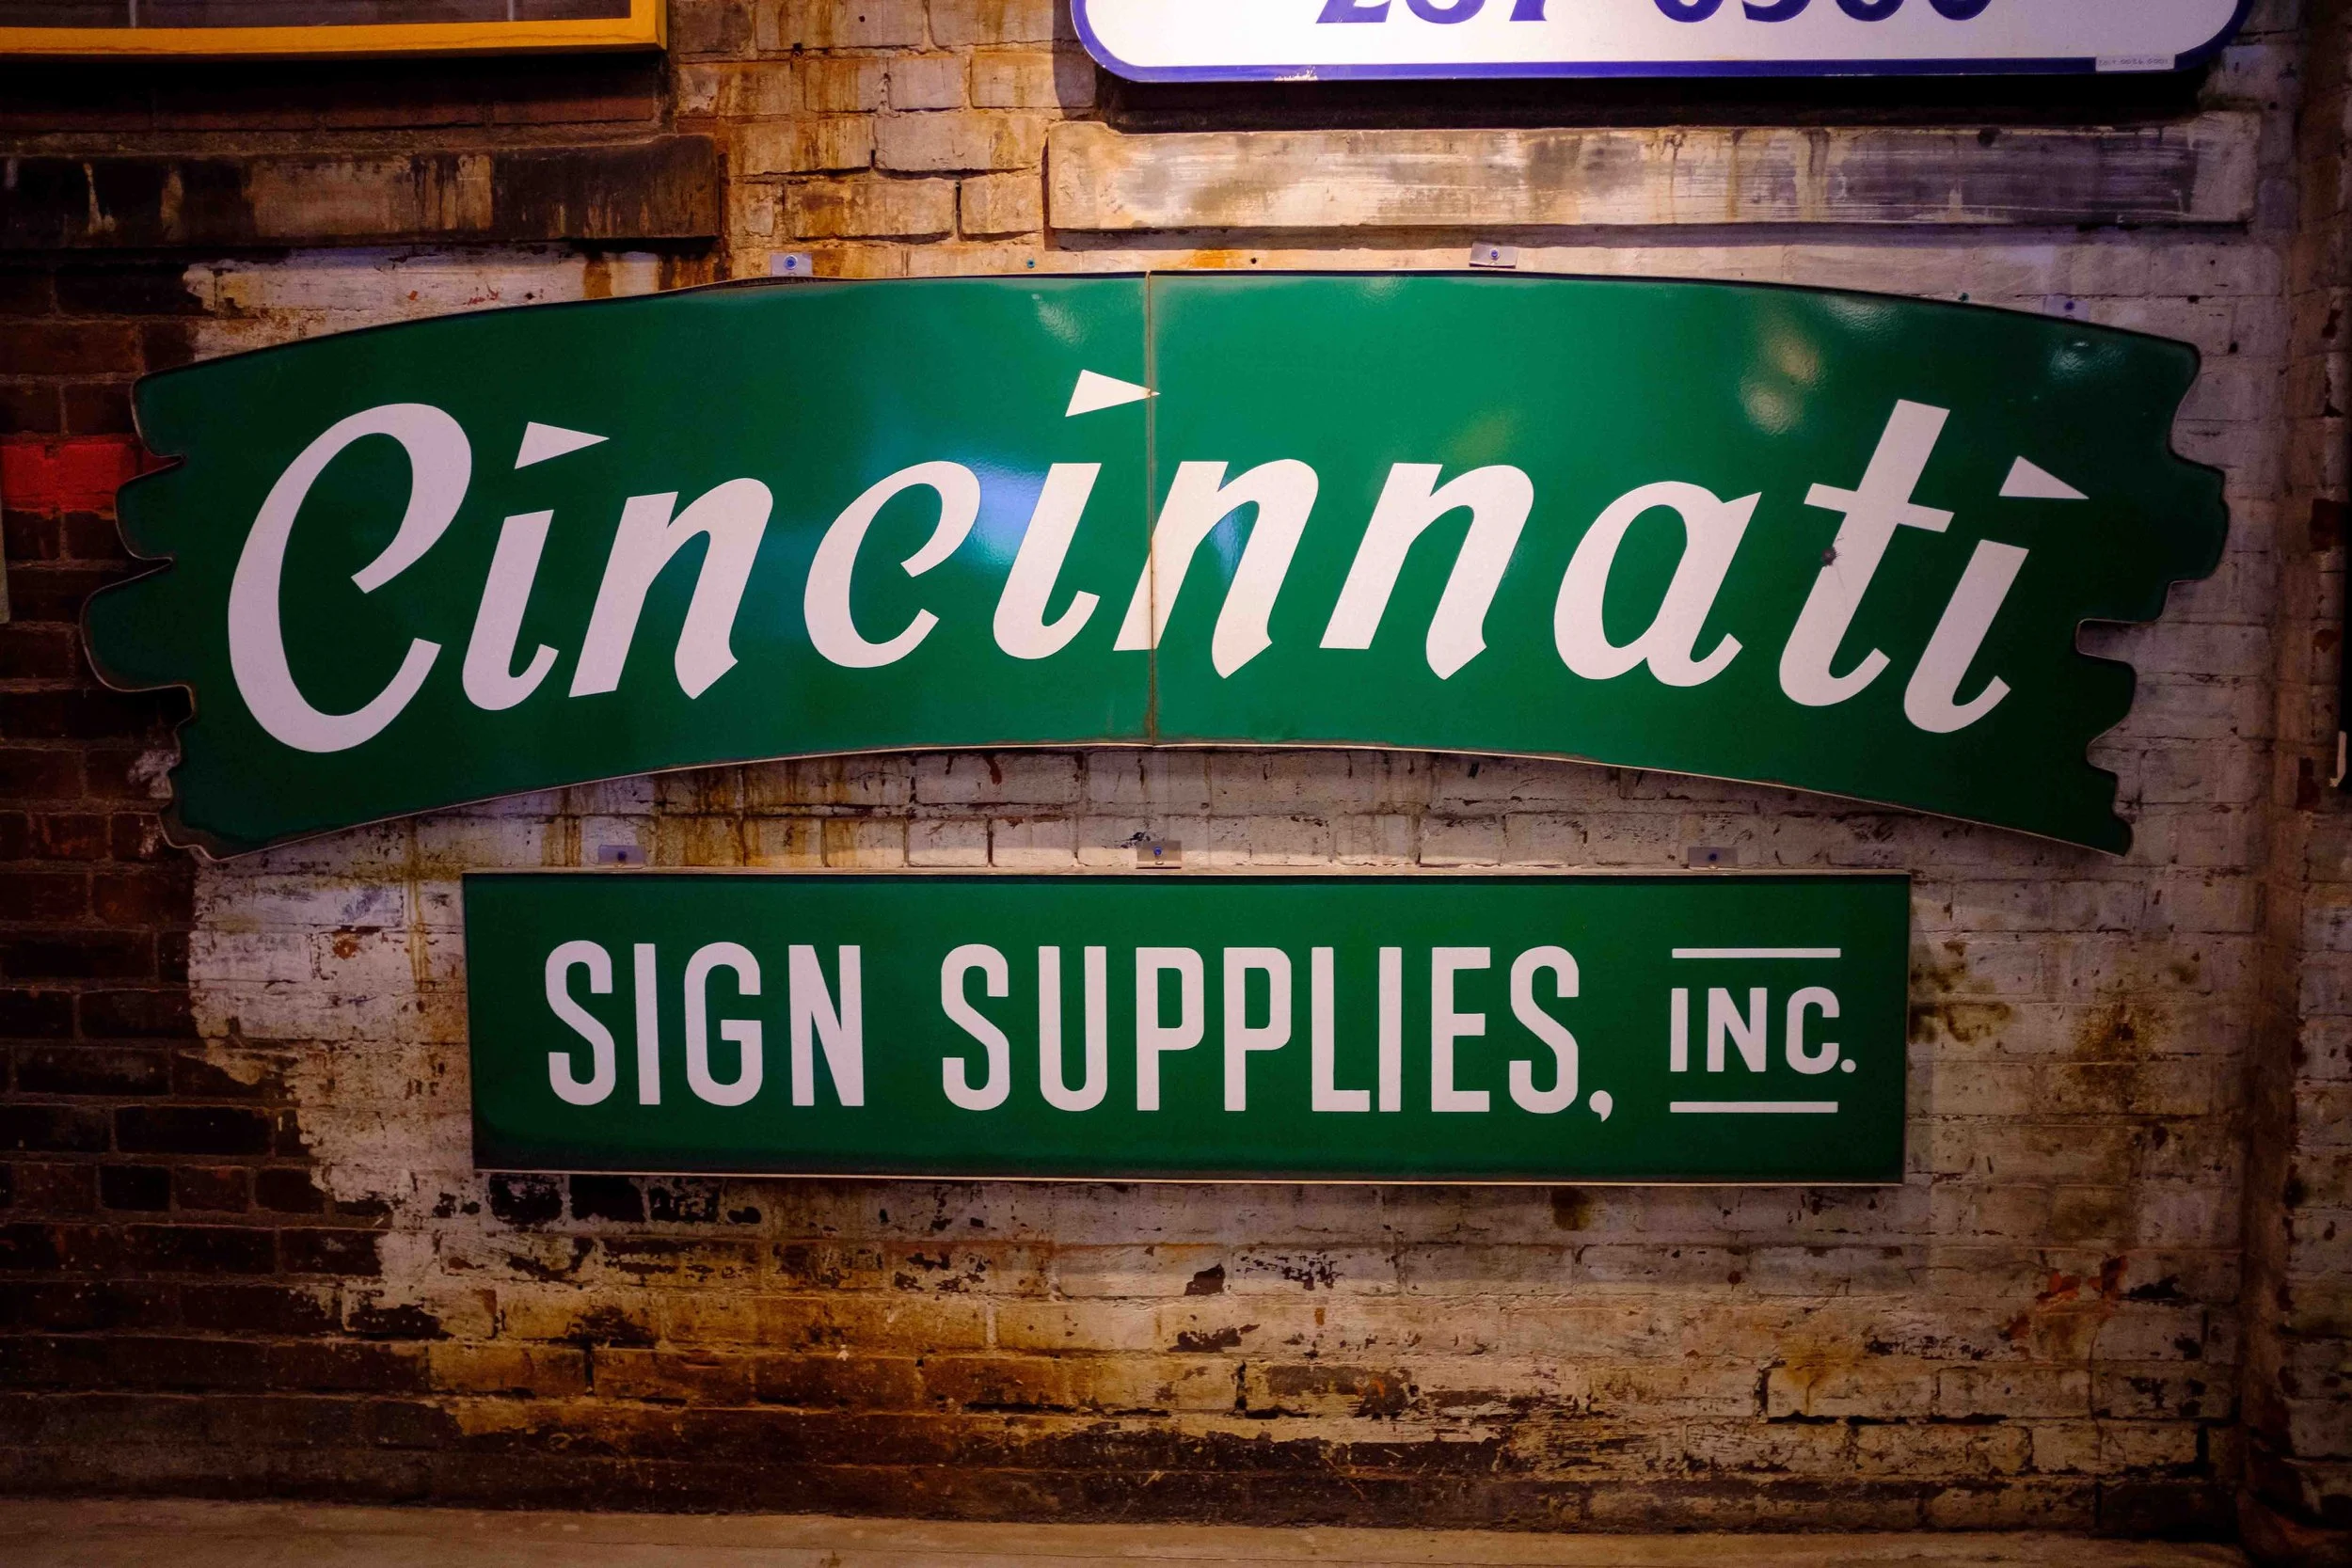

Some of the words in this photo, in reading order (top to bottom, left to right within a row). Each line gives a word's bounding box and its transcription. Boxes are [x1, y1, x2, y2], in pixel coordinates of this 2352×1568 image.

[227, 369, 2090, 753] Cincinnati
[545, 940, 866, 1108] SIGN
[941, 943, 1613, 1122] SUPPLIES,
[1669, 986, 1857, 1074] INC.
